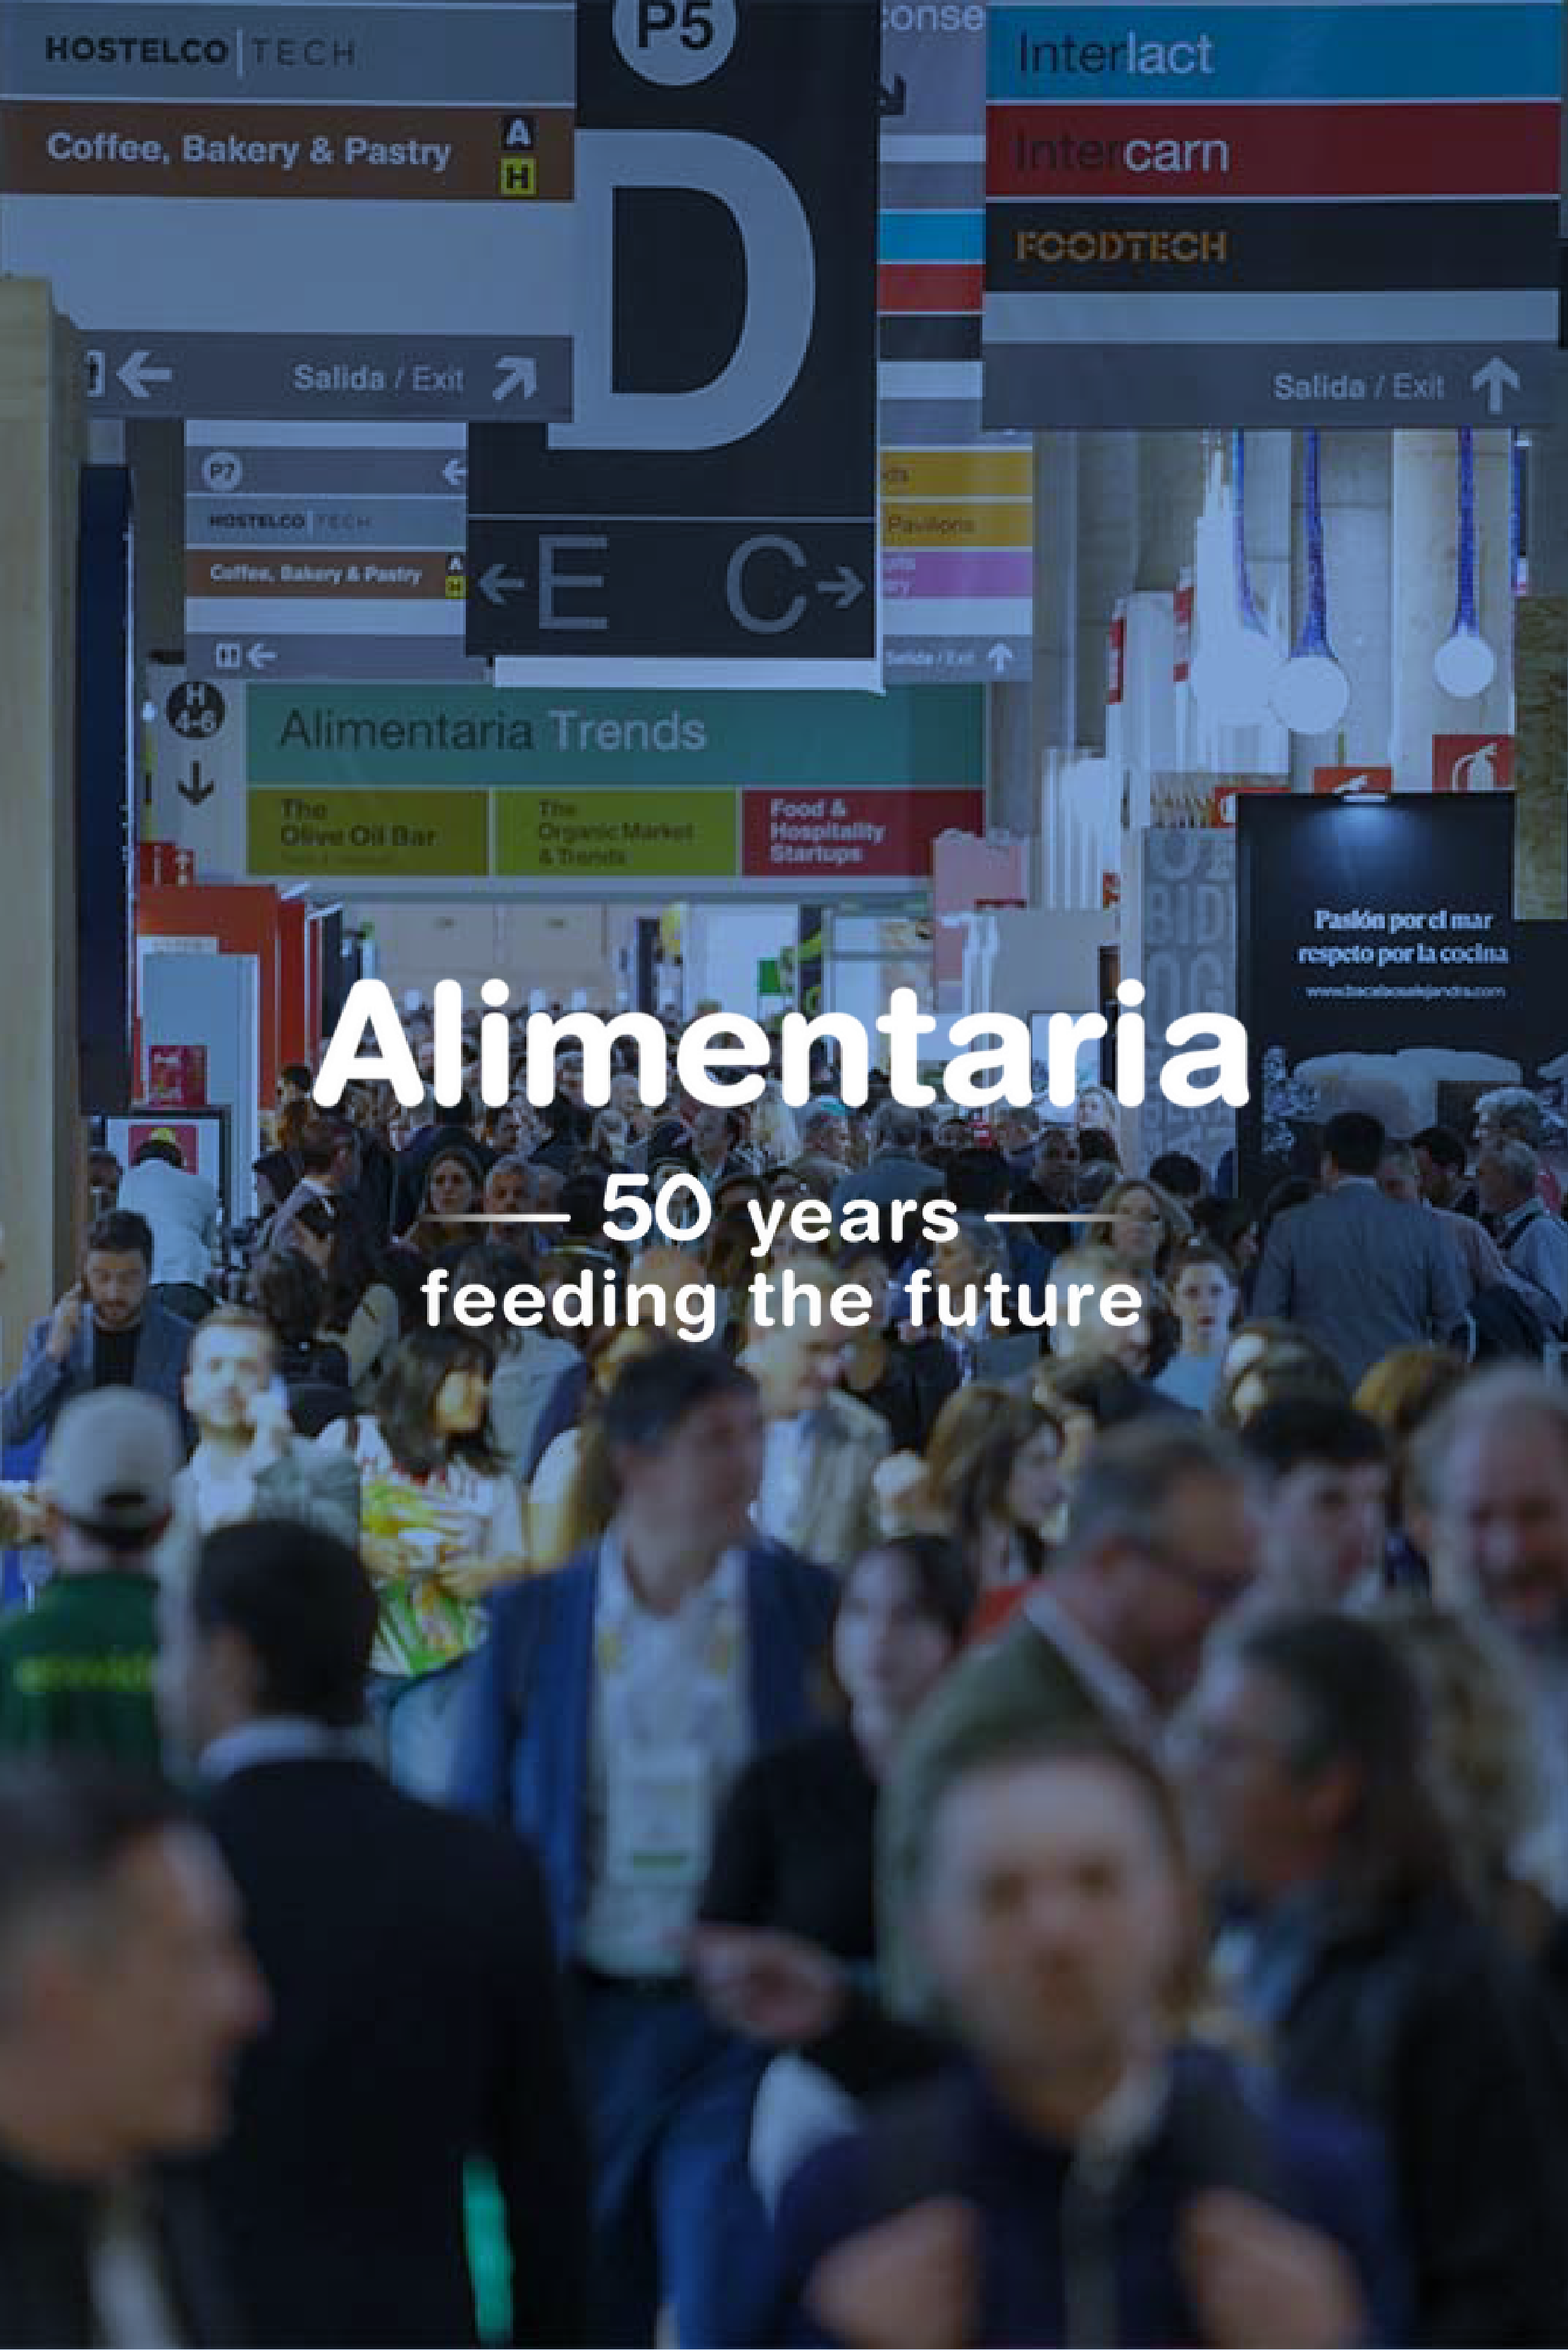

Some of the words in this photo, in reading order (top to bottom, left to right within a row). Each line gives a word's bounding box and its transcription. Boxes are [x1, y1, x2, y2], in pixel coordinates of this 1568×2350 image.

[636, 0, 715, 51] P5
[45, 36, 229, 65] HOSTELCO
[252, 37, 357, 66] TECH
[1019, 31, 1214, 75] Interlact
[507, 118, 530, 145] A
[47, 132, 171, 165] Coffee,
[183, 134, 300, 170] Bakery
[309, 138, 334, 165] &
[344, 138, 452, 171] Pastry
[1015, 134, 1230, 172] Intercarn
[508, 164, 530, 189] H
[1015, 231, 1226, 263] FOODTECH
[547, 129, 815, 451] D
[294, 363, 385, 391] Salida
[412, 365, 464, 392] Exit
[1273, 374, 1365, 401] Salida
[1393, 374, 1445, 400] Exit
[210, 462, 235, 481] P7
[209, 513, 305, 530] HOSTELCO
[210, 563, 276, 584] Coffee,
[280, 563, 343, 585] Bakery
[364, 565, 423, 586] Pastry
[538, 535, 609, 629] E
[726, 534, 808, 633] C
[186, 684, 205, 706] H
[280, 708, 534, 751] Alimentaria
[549, 709, 708, 751] Trends
[282, 798, 328, 820] The
[538, 798, 576, 816] The
[770, 799, 824, 818] Food
[829, 798, 848, 818] &
[281, 824, 344, 847] Olive
[352, 824, 385, 847] Oil
[392, 824, 437, 847] Bar
[538, 822, 619, 843] Organic
[623, 822, 694, 840] Market
[771, 822, 887, 842] Hospitality
[770, 845, 864, 866] Startups
[1299, 945, 1375, 968] respeto
[1439, 943, 1509, 964] cocina
